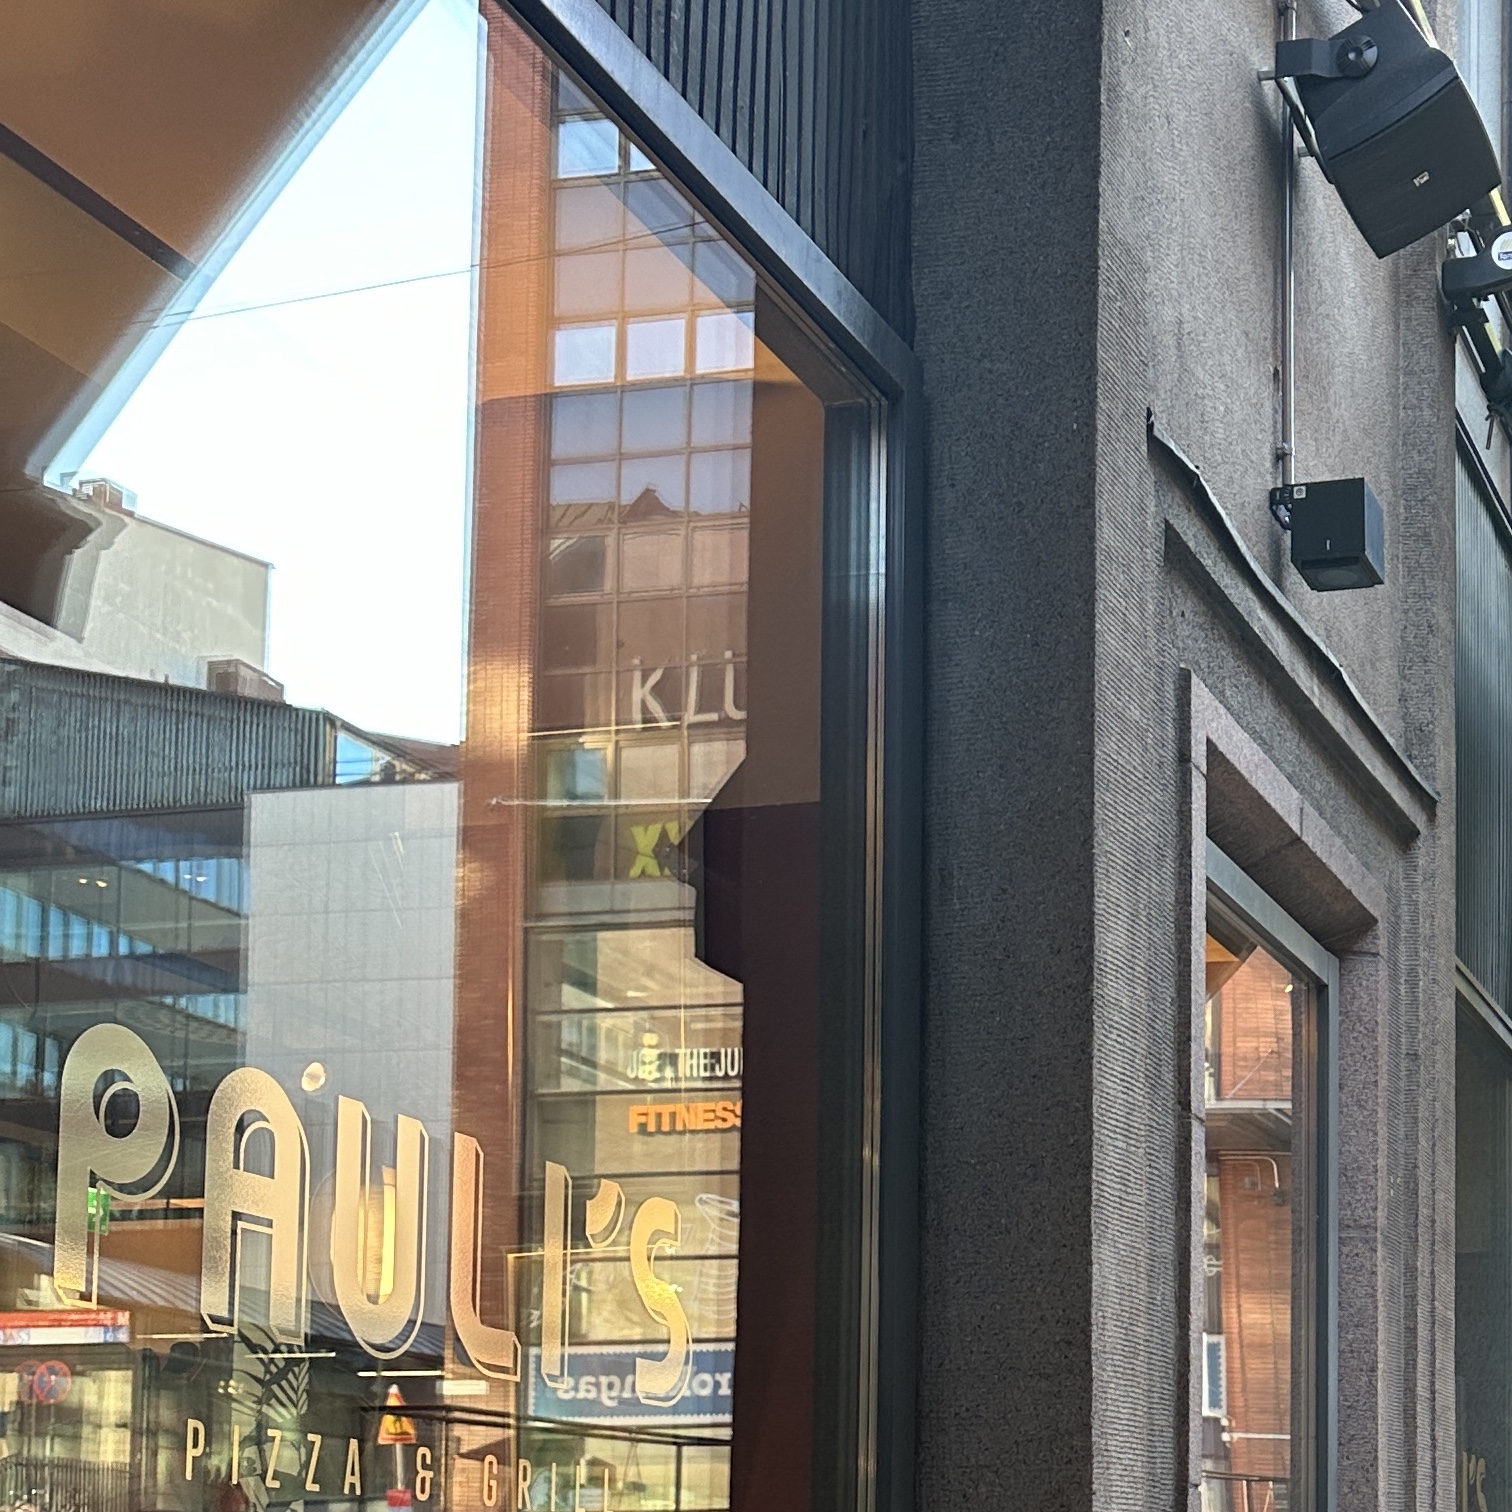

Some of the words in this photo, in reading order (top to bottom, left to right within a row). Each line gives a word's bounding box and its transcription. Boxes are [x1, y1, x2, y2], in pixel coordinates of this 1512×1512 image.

[53, 1022, 693, 1408] PAULI'S
[185, 1418, 362, 1496] PIZZA
[415, 1446, 435, 1502] &
